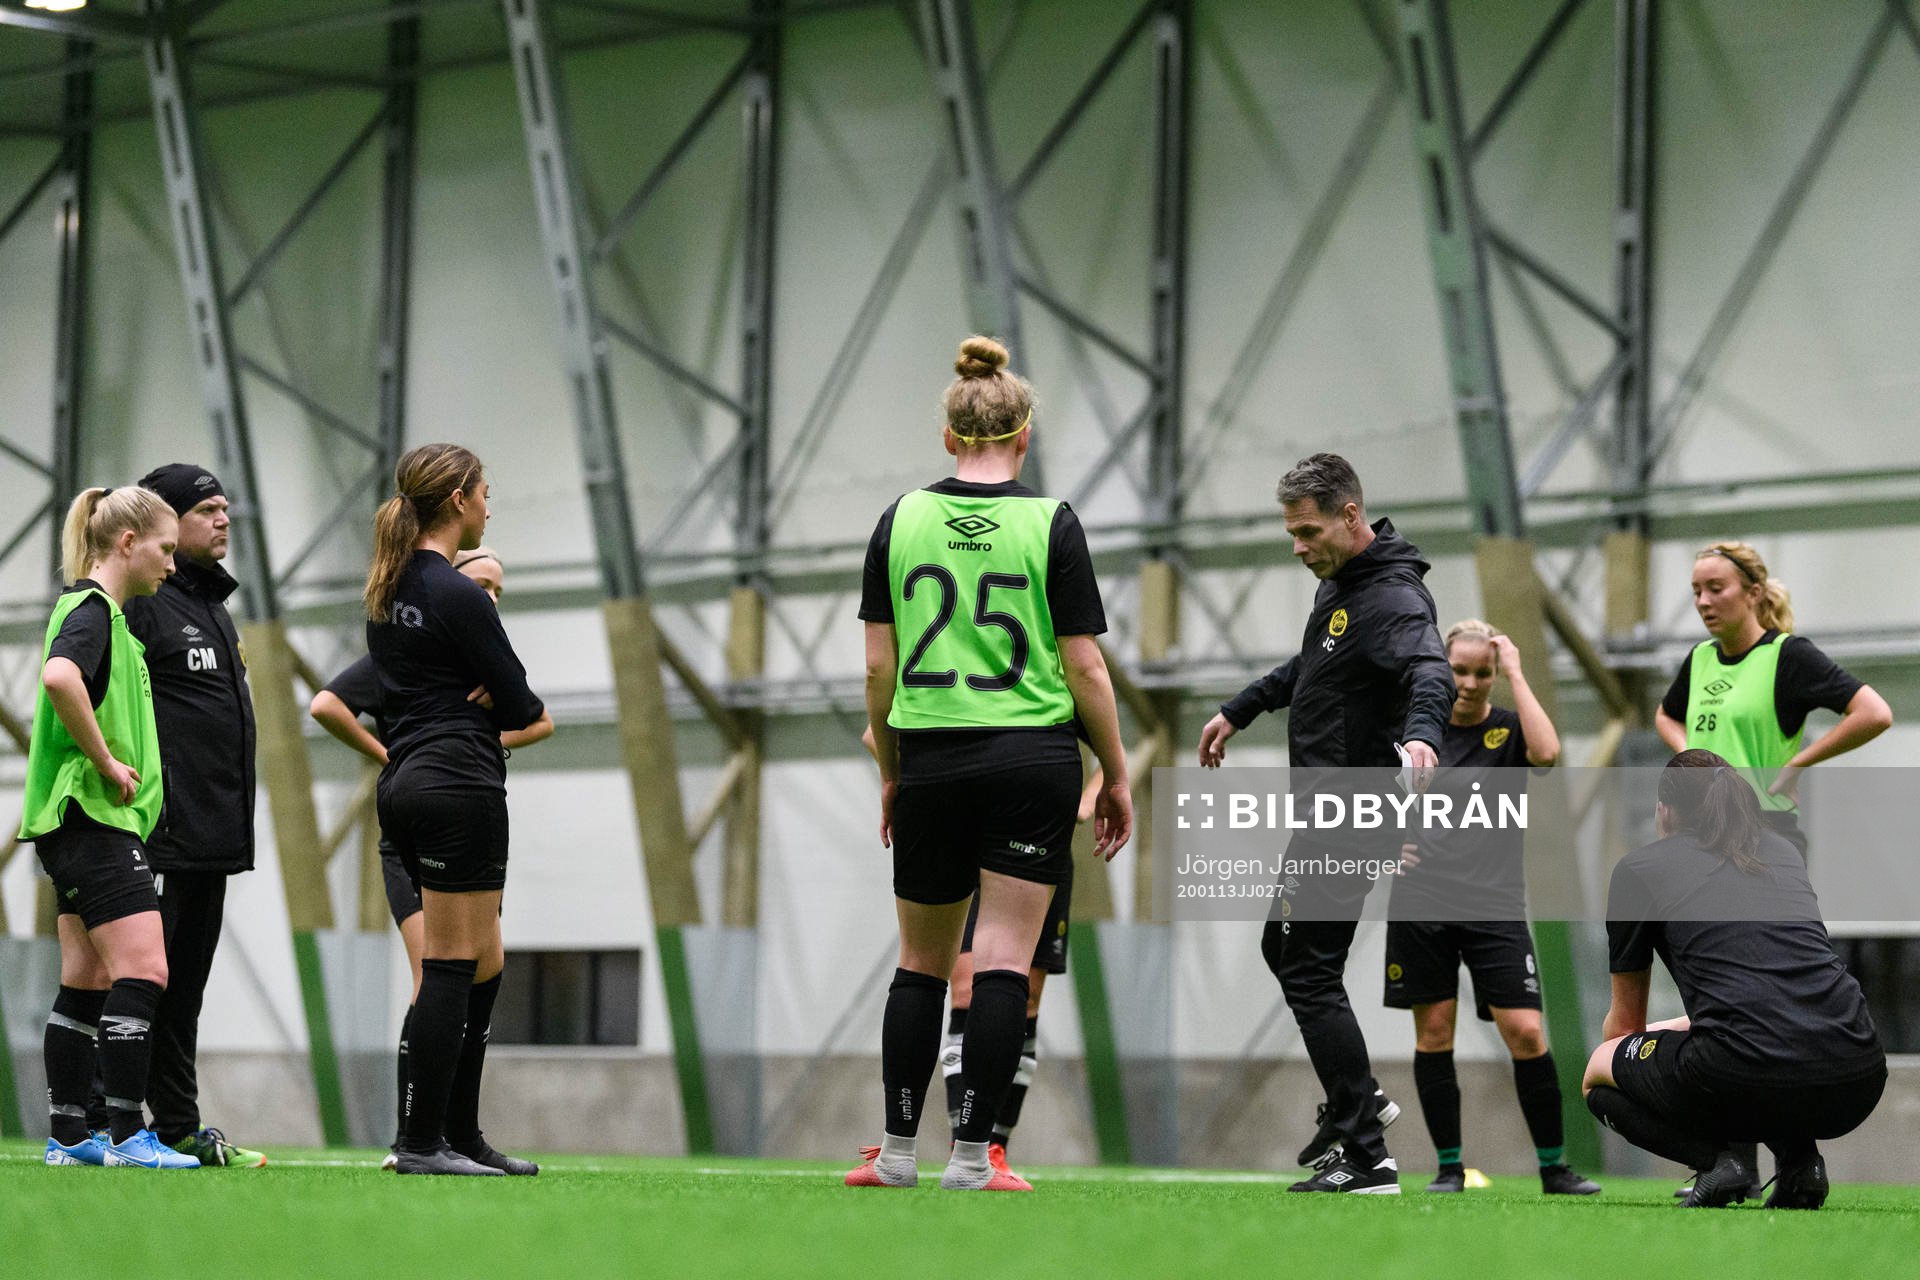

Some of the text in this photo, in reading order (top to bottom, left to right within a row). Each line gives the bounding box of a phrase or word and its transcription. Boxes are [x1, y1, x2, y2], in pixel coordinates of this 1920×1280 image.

[947, 539, 993, 552] umbro
[902, 563, 1030, 692] 25
[187, 647, 218, 672] CM
[1695, 713, 1717, 732] 26
[1525, 953, 1536, 975] 6
[405, 1082, 414, 1117] umbro
[899, 1087, 913, 1121] umbro
[961, 1089, 976, 1125] umbro
